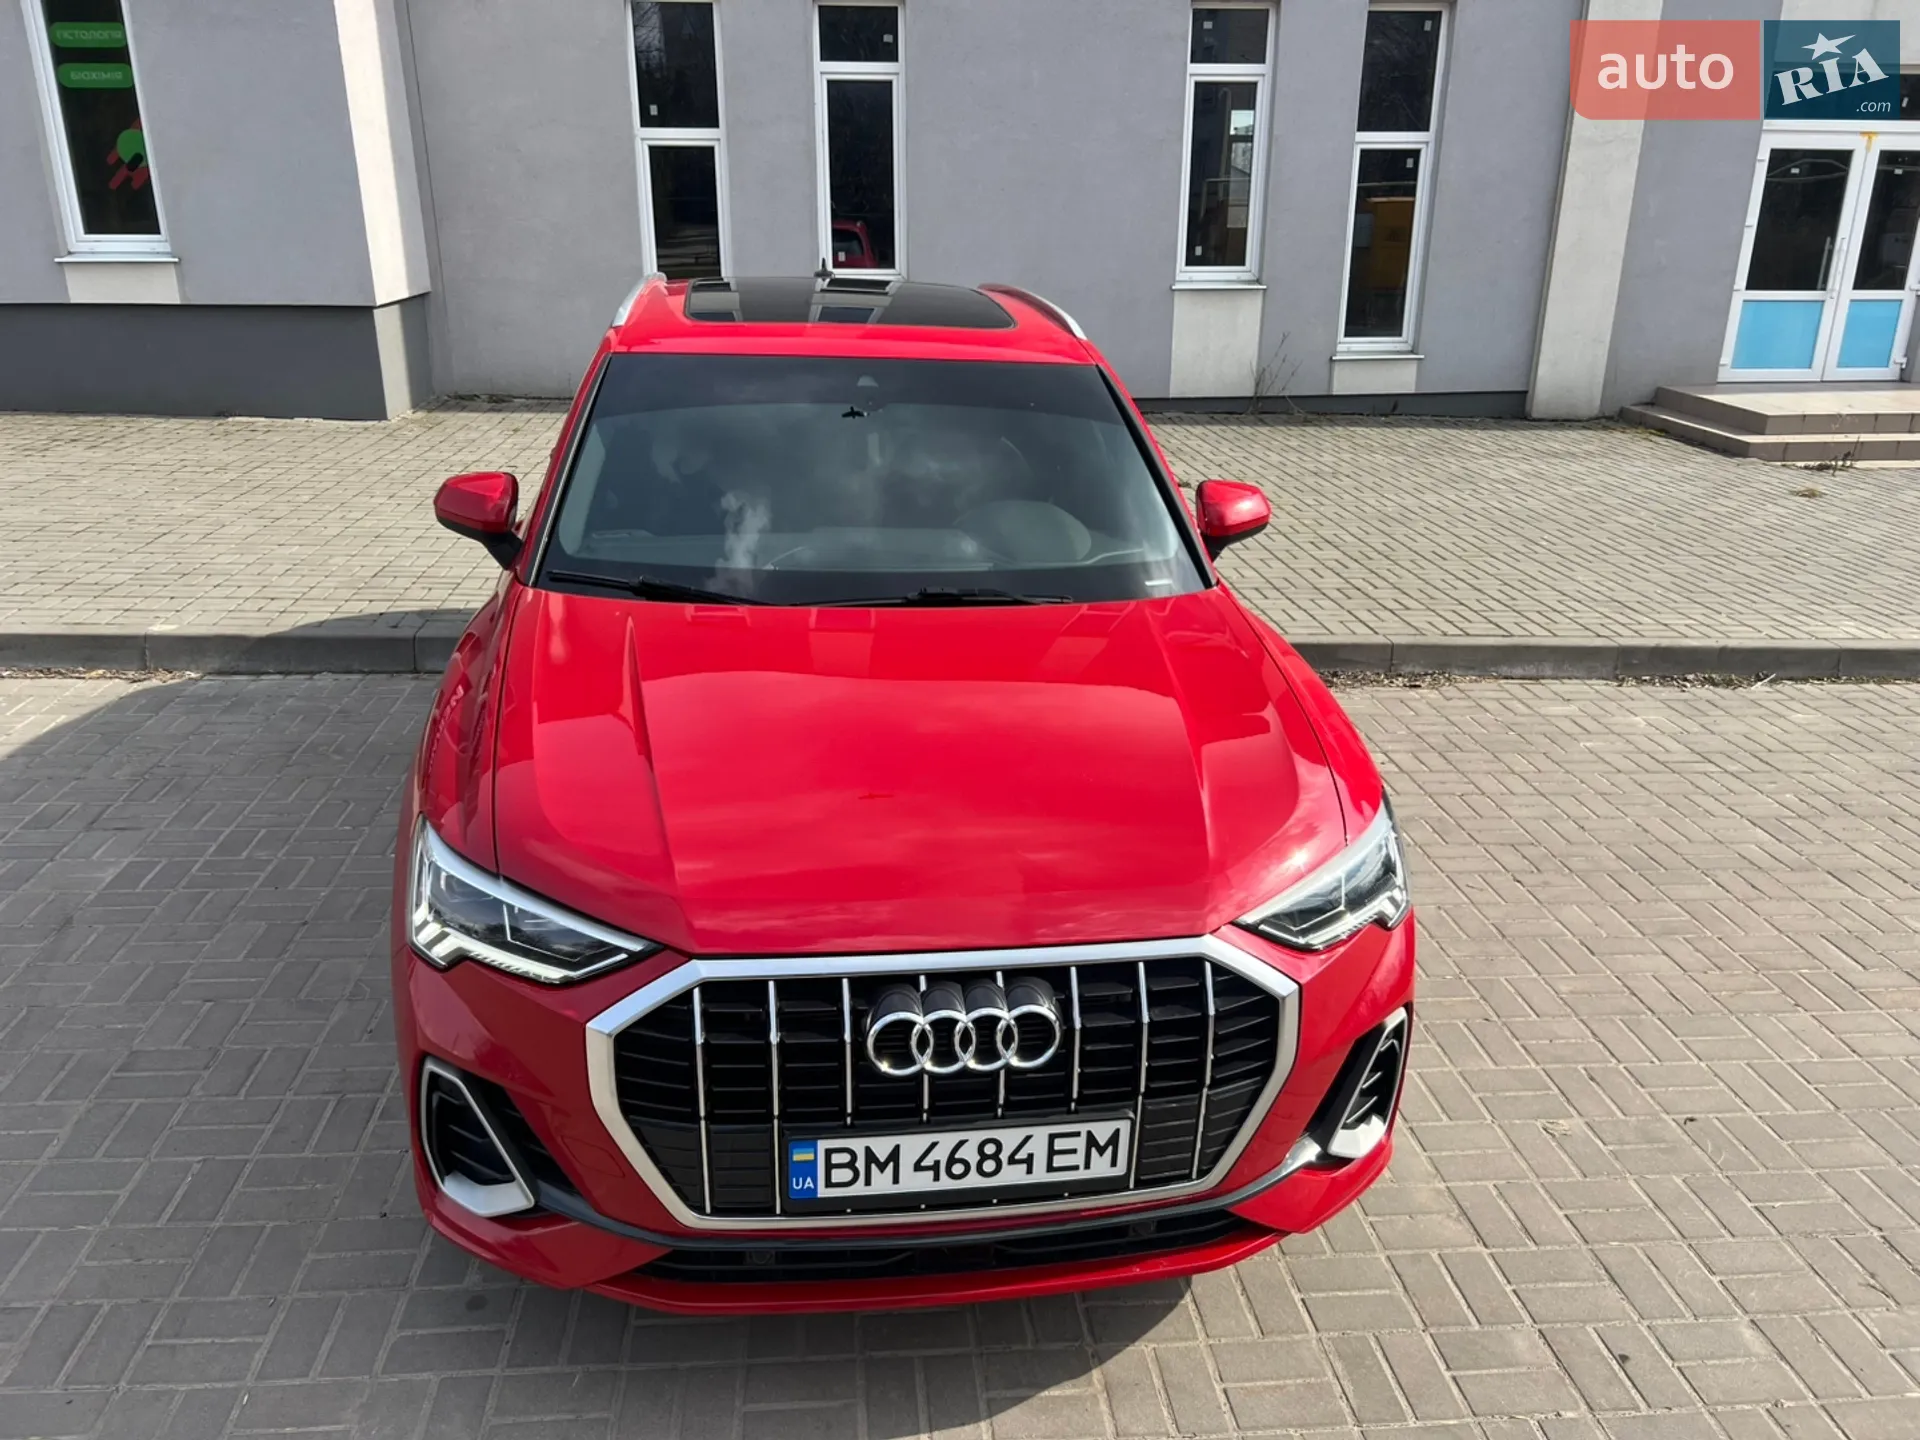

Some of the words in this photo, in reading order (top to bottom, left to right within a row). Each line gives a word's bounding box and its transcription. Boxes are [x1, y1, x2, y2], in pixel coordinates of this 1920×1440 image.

[823, 1143, 901, 1189] BM
[913, 1134, 1035, 1183] 4684
[1045, 1127, 1122, 1174] EM
[792, 1177, 815, 1190] UA
